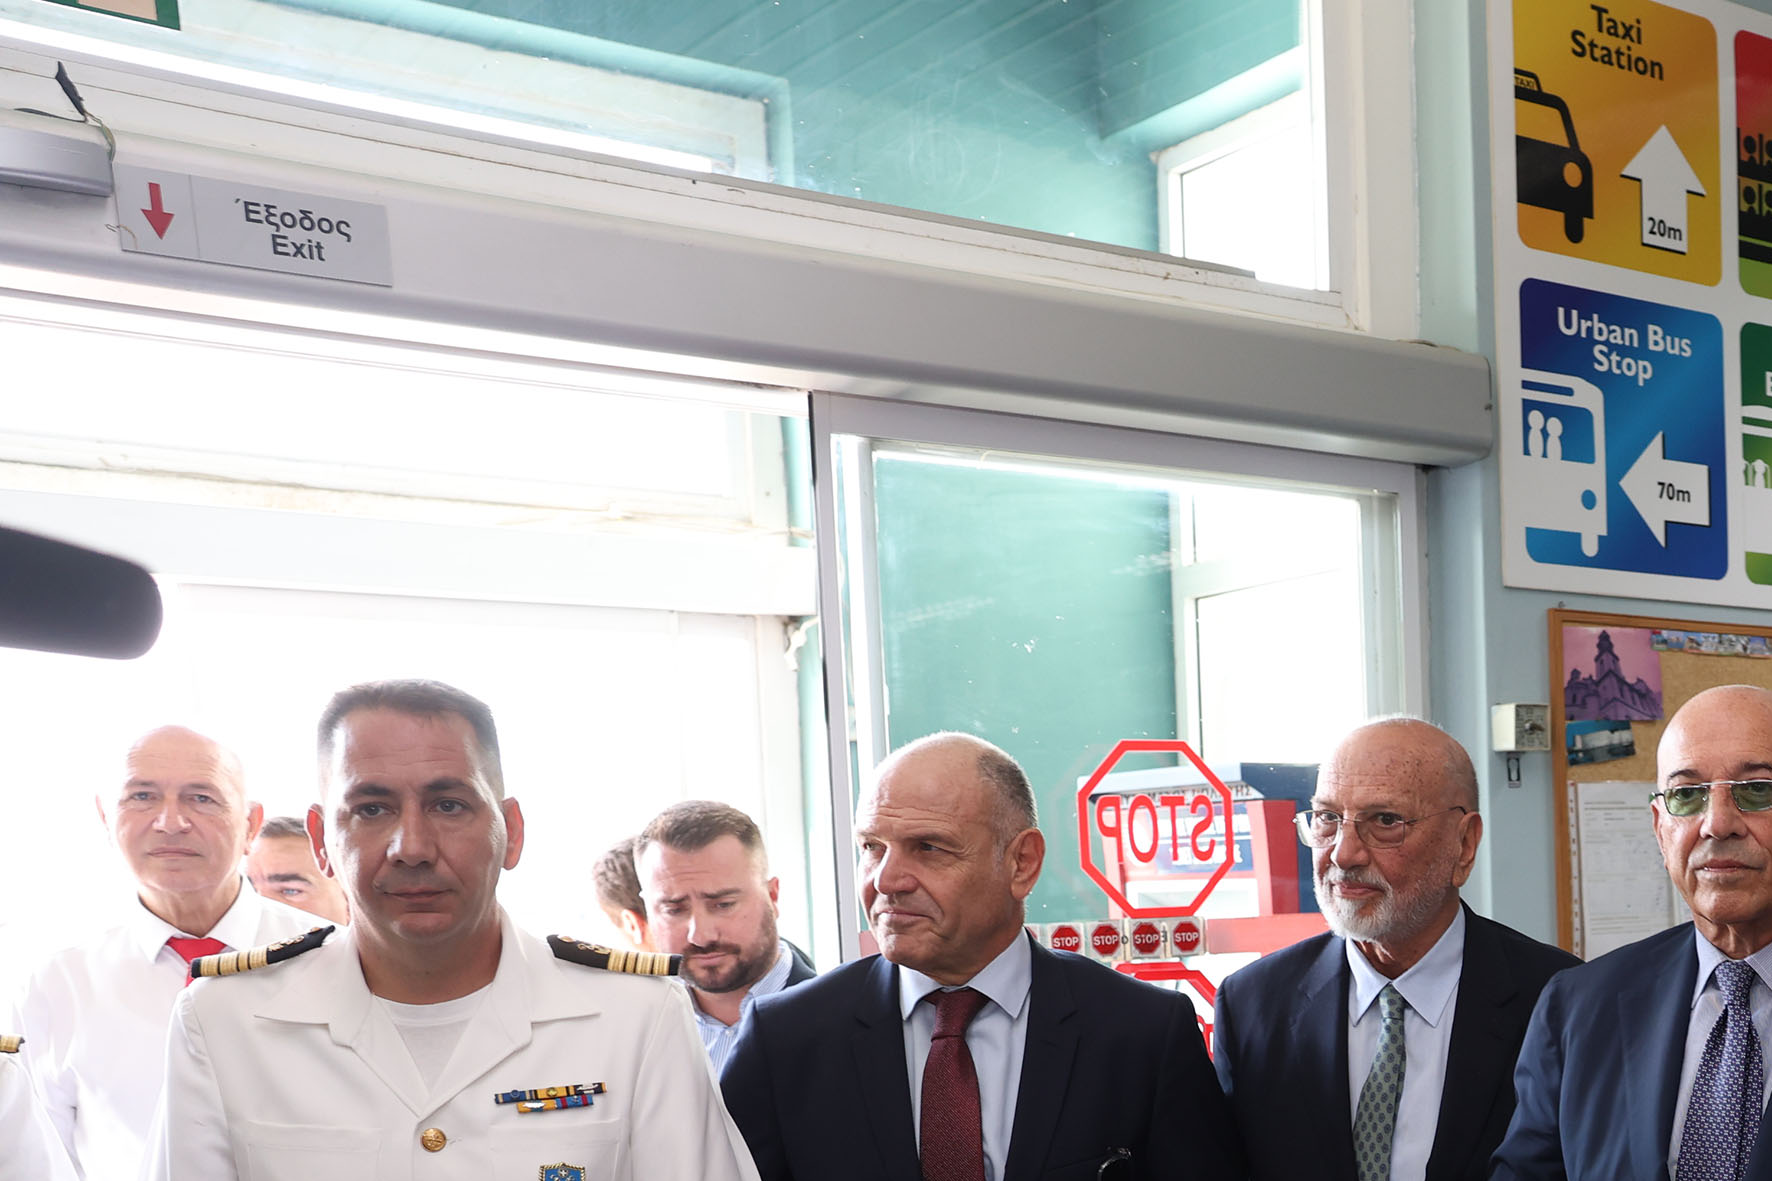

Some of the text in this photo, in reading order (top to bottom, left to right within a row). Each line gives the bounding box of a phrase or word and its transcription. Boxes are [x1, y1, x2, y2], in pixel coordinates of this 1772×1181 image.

[1590, 4, 1642, 45] Taxi
[1571, 29, 1664, 81] Station
[234, 198, 352, 242] Έξοδος
[1648, 217, 1682, 242] 20m
[271, 233, 326, 262] Exit
[1557, 306, 1693, 358] Urban Bus
[1593, 344, 1653, 387] Stop
[1657, 482, 1691, 503] 70m
[1053, 937, 1080, 949] STOP
[1093, 934, 1119, 947] STOP
[1134, 933, 1160, 946] STOP
[1174, 931, 1200, 944] STOP
